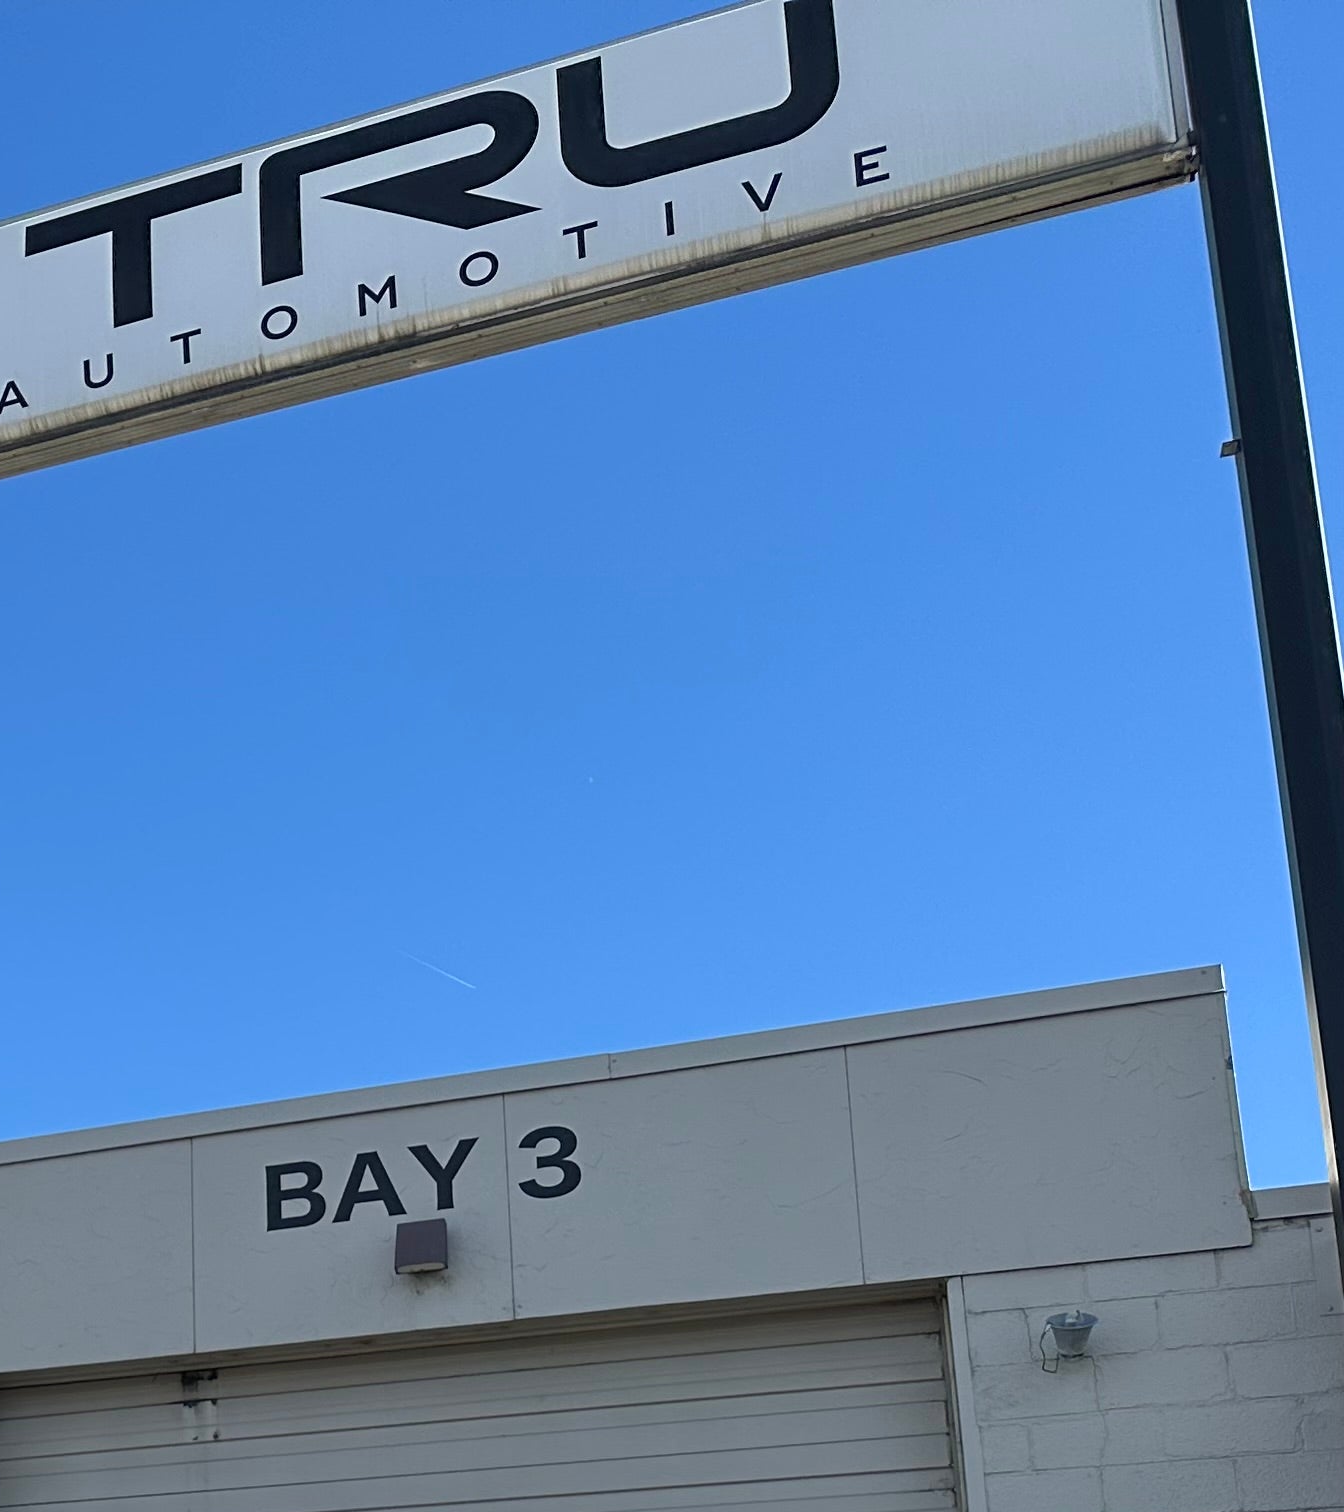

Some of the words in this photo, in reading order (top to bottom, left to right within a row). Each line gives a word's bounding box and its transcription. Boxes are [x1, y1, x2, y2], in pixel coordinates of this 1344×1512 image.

[25, 0, 840, 328] TRU
[265, 1137, 479, 1232] BAY
[518, 1126, 582, 1199] 3
